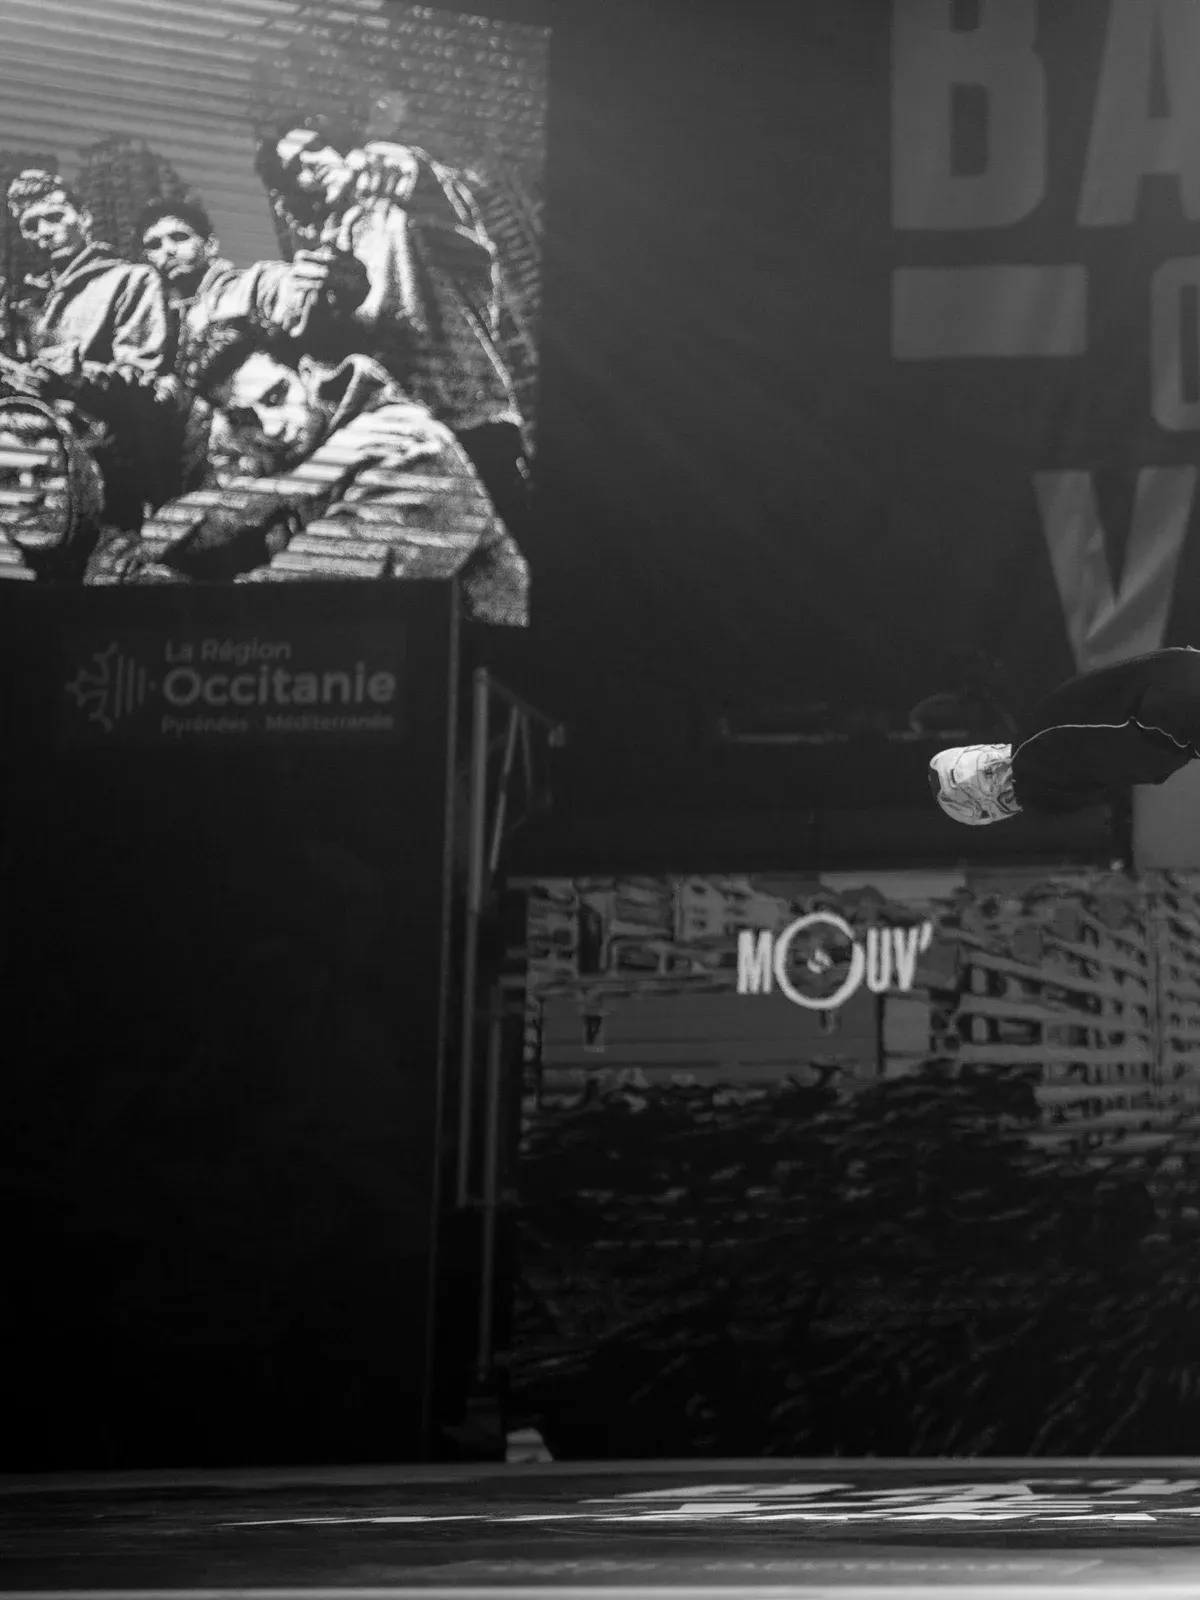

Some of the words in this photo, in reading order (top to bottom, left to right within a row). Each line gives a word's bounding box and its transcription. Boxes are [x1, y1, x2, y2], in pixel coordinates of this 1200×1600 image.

[164, 638, 194, 663] La
[200, 637, 293, 666] Région
[161, 660, 398, 706] Occitanie
